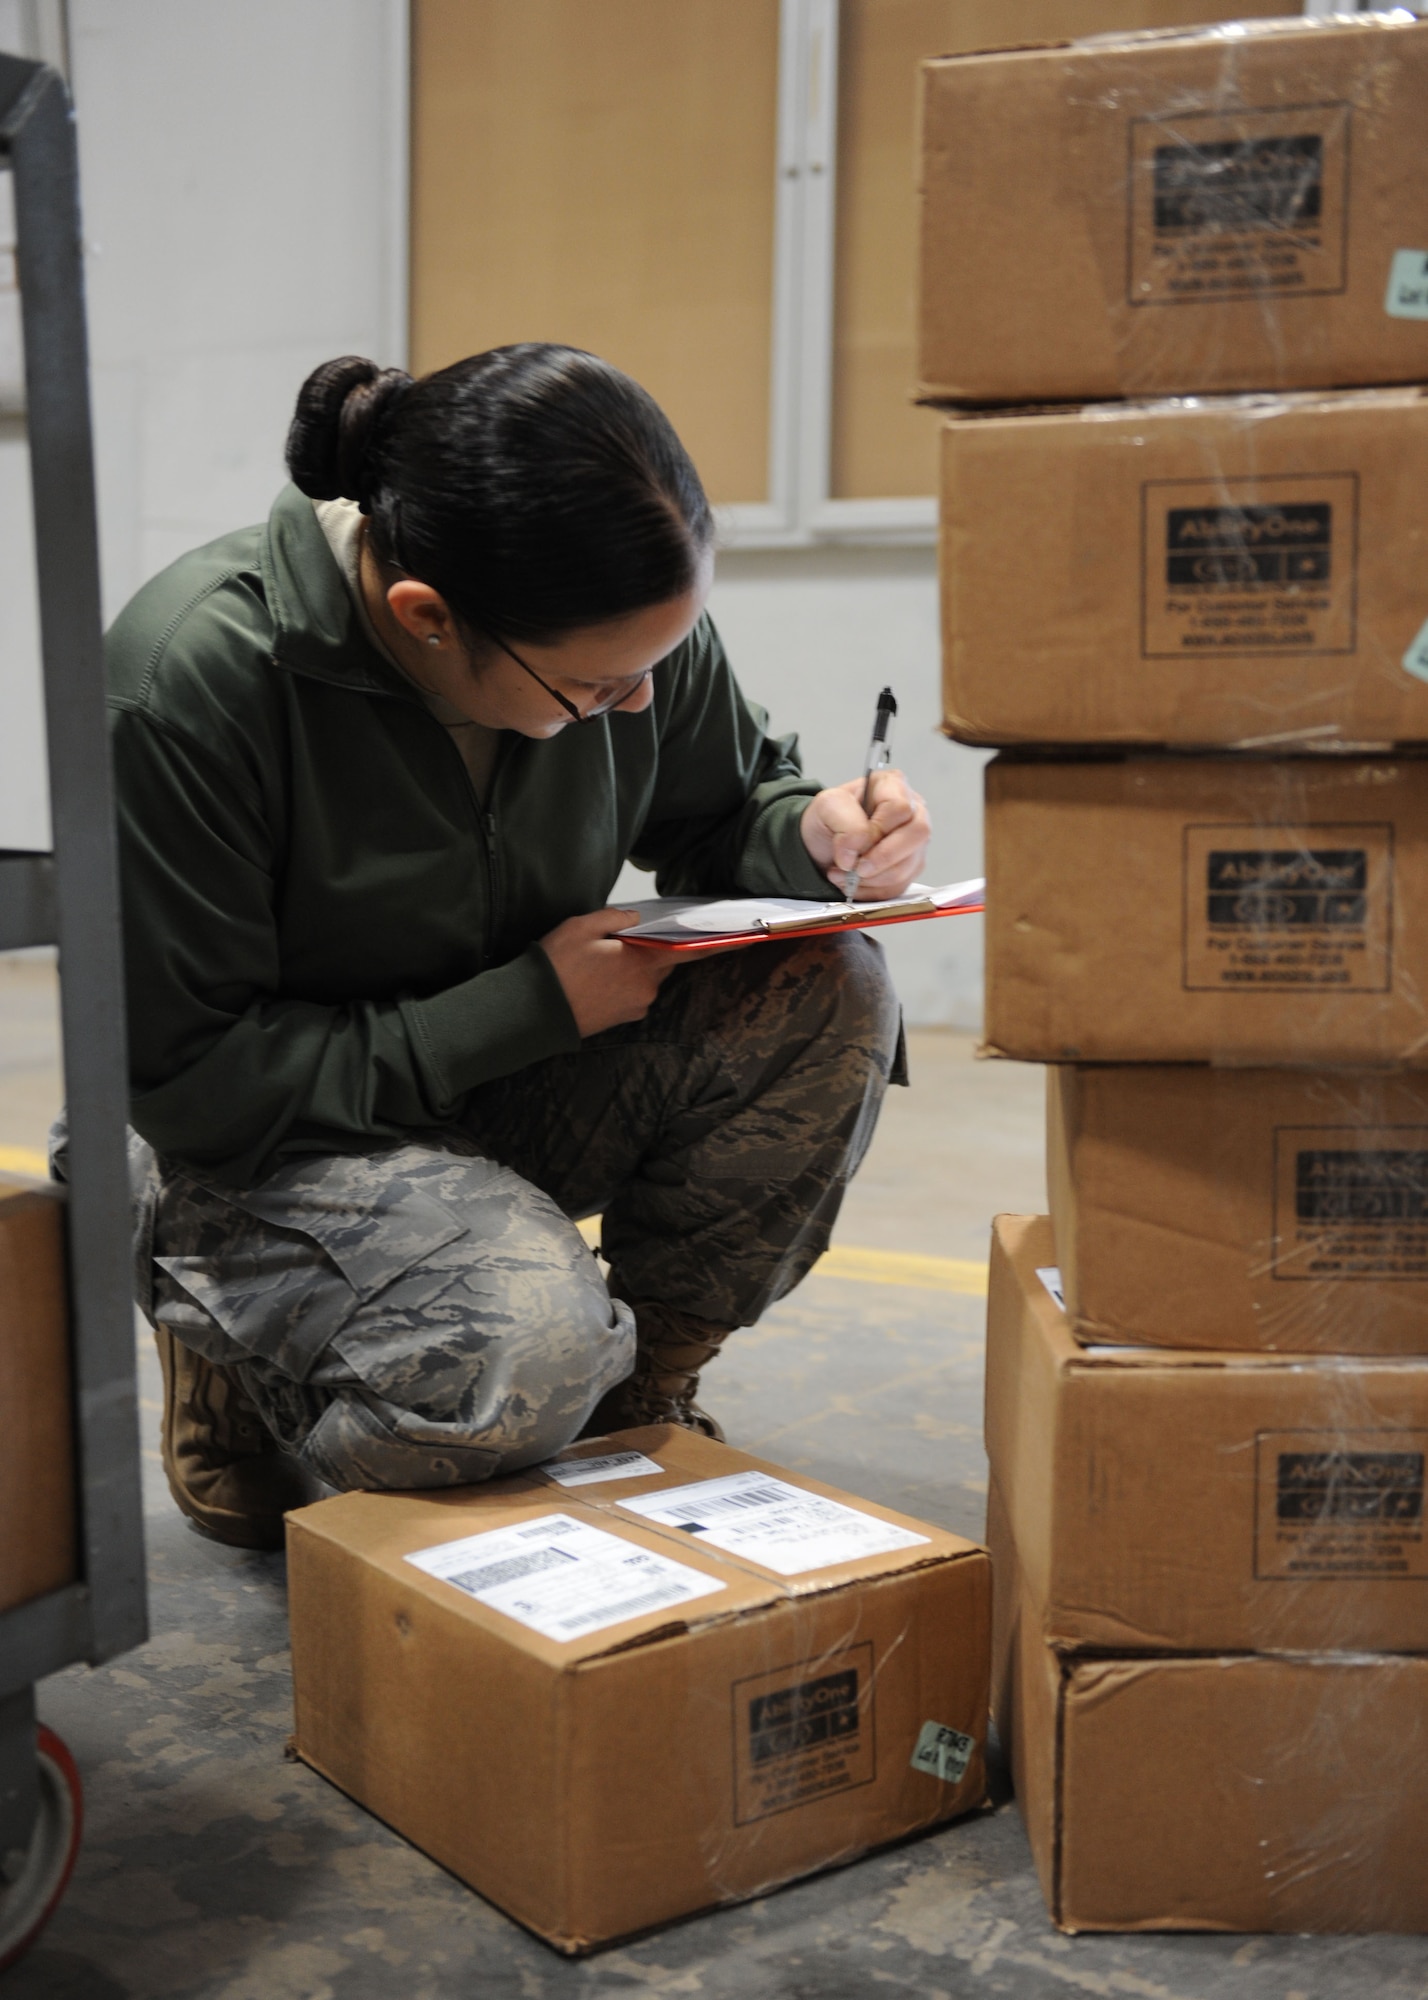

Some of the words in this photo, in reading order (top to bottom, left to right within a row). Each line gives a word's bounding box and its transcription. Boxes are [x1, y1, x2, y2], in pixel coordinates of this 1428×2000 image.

[1178, 514, 1321, 542] AbilityOne
[1218, 861, 1357, 886] AbilityOne
[1289, 1461, 1415, 1482] AbilityOne
[759, 1683, 851, 1722] AbilityOne
